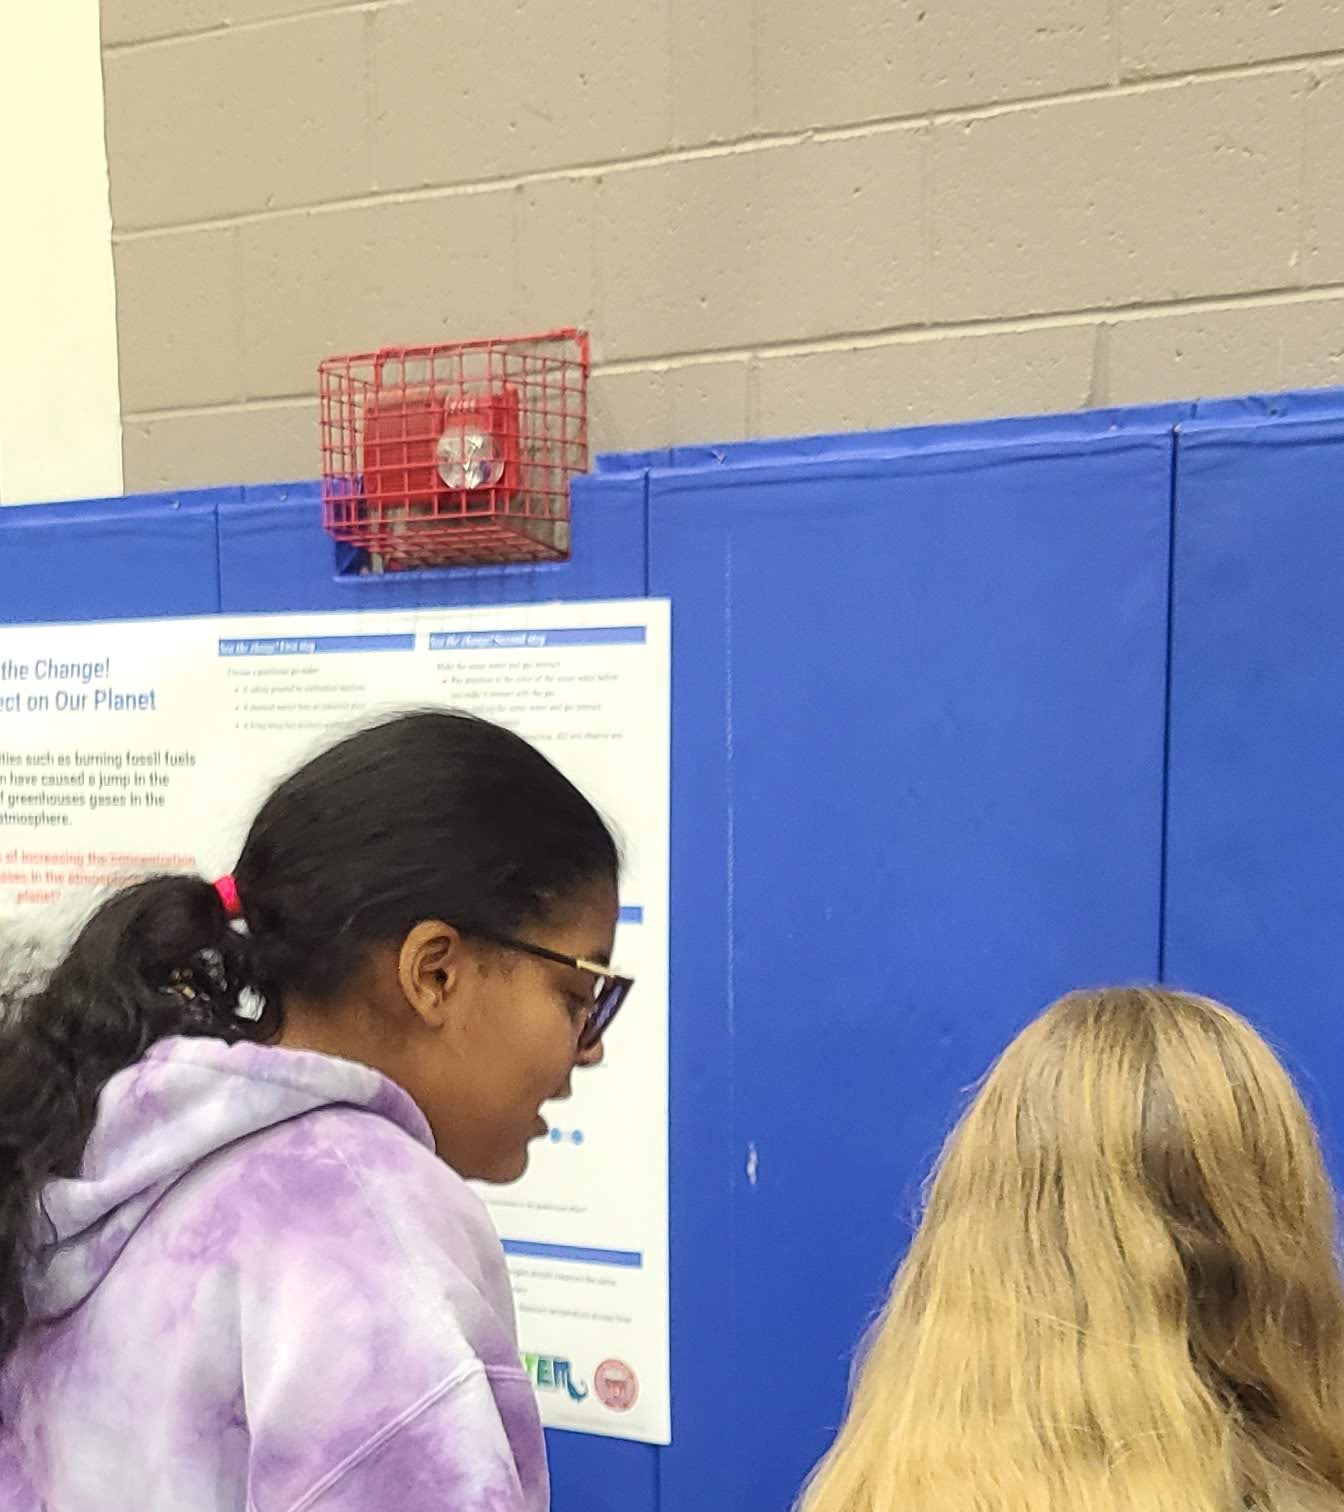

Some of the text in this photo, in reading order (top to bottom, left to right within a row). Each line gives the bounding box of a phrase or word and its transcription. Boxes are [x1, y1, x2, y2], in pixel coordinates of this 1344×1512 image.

[1, 658, 29, 681] the
[35, 656, 110, 684] Change!
[27, 694, 50, 712] on
[55, 689, 88, 712] Our
[94, 687, 157, 711] Planet
[26, 749, 55, 767] such
[75, 748, 123, 771] burning
[126, 748, 161, 767] fossil
[165, 748, 196, 767] fuels
[10, 770, 38, 787] have
[41, 769, 85, 787] caused
[99, 770, 131, 791] jump
[134, 771, 146, 787] in
[149, 771, 169, 787] the
[7, 789, 86, 810] greenhouses
[89, 793, 127, 810] gases
[130, 791, 142, 807] in
[145, 791, 165, 807] the
